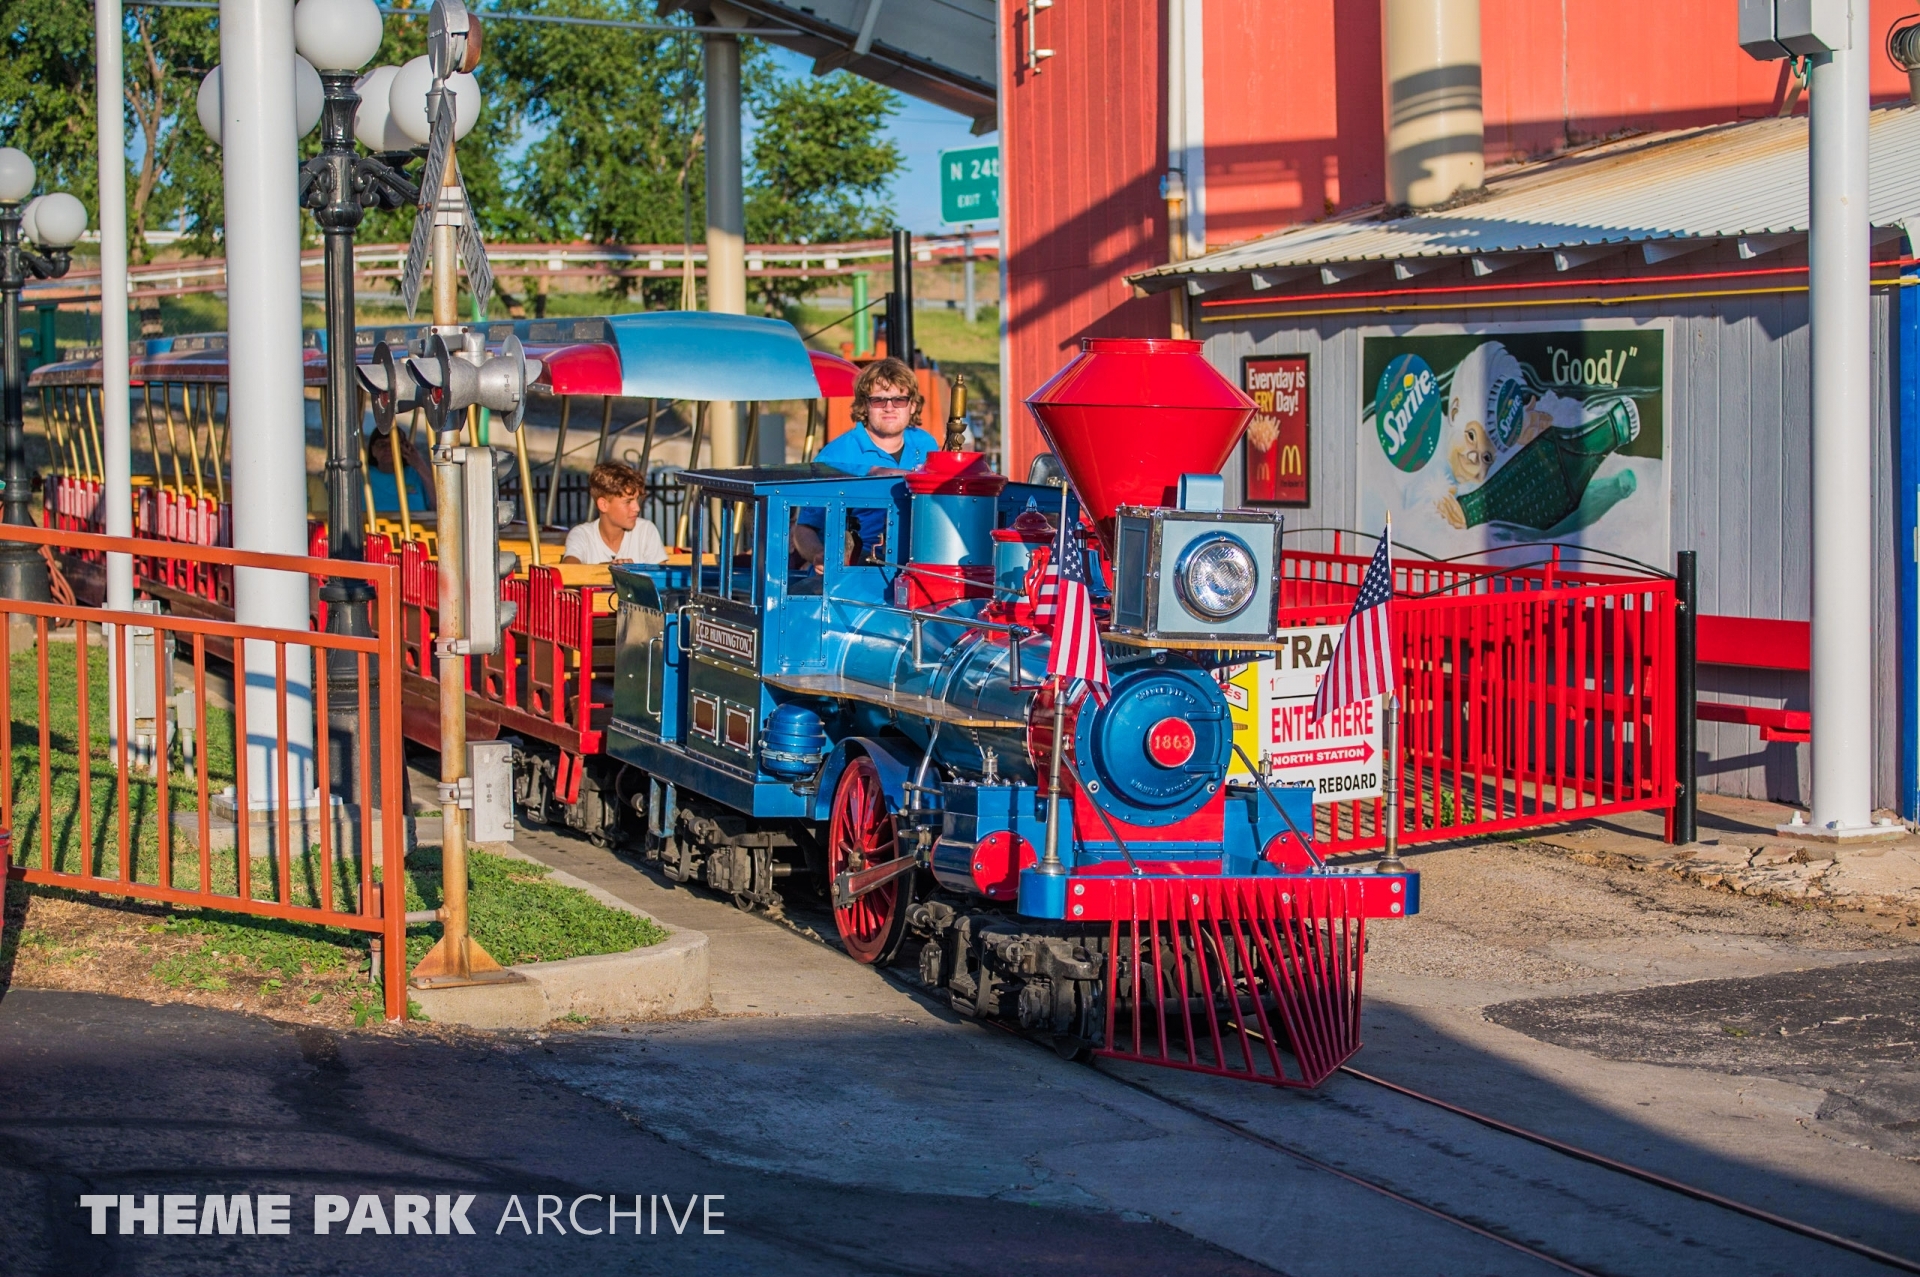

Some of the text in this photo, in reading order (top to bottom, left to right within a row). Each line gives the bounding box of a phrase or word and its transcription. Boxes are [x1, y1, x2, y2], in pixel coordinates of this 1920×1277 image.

[950, 162, 963, 181] N
[1249, 366, 1306, 393] Everyday is
[1254, 390, 1299, 416] FRY Day!
[1383, 370, 1432, 456] Sprite
[1500, 395, 1520, 438] Sprite
[710, 628, 749, 653] HUNTINGTON
[1275, 633, 1343, 671] TRA
[1272, 700, 1374, 744] ENTER HERE
[1154, 734, 1192, 750] 1863
[1273, 748, 1365, 766] NORTH STATION
[1319, 772, 1377, 794] REBOARD
